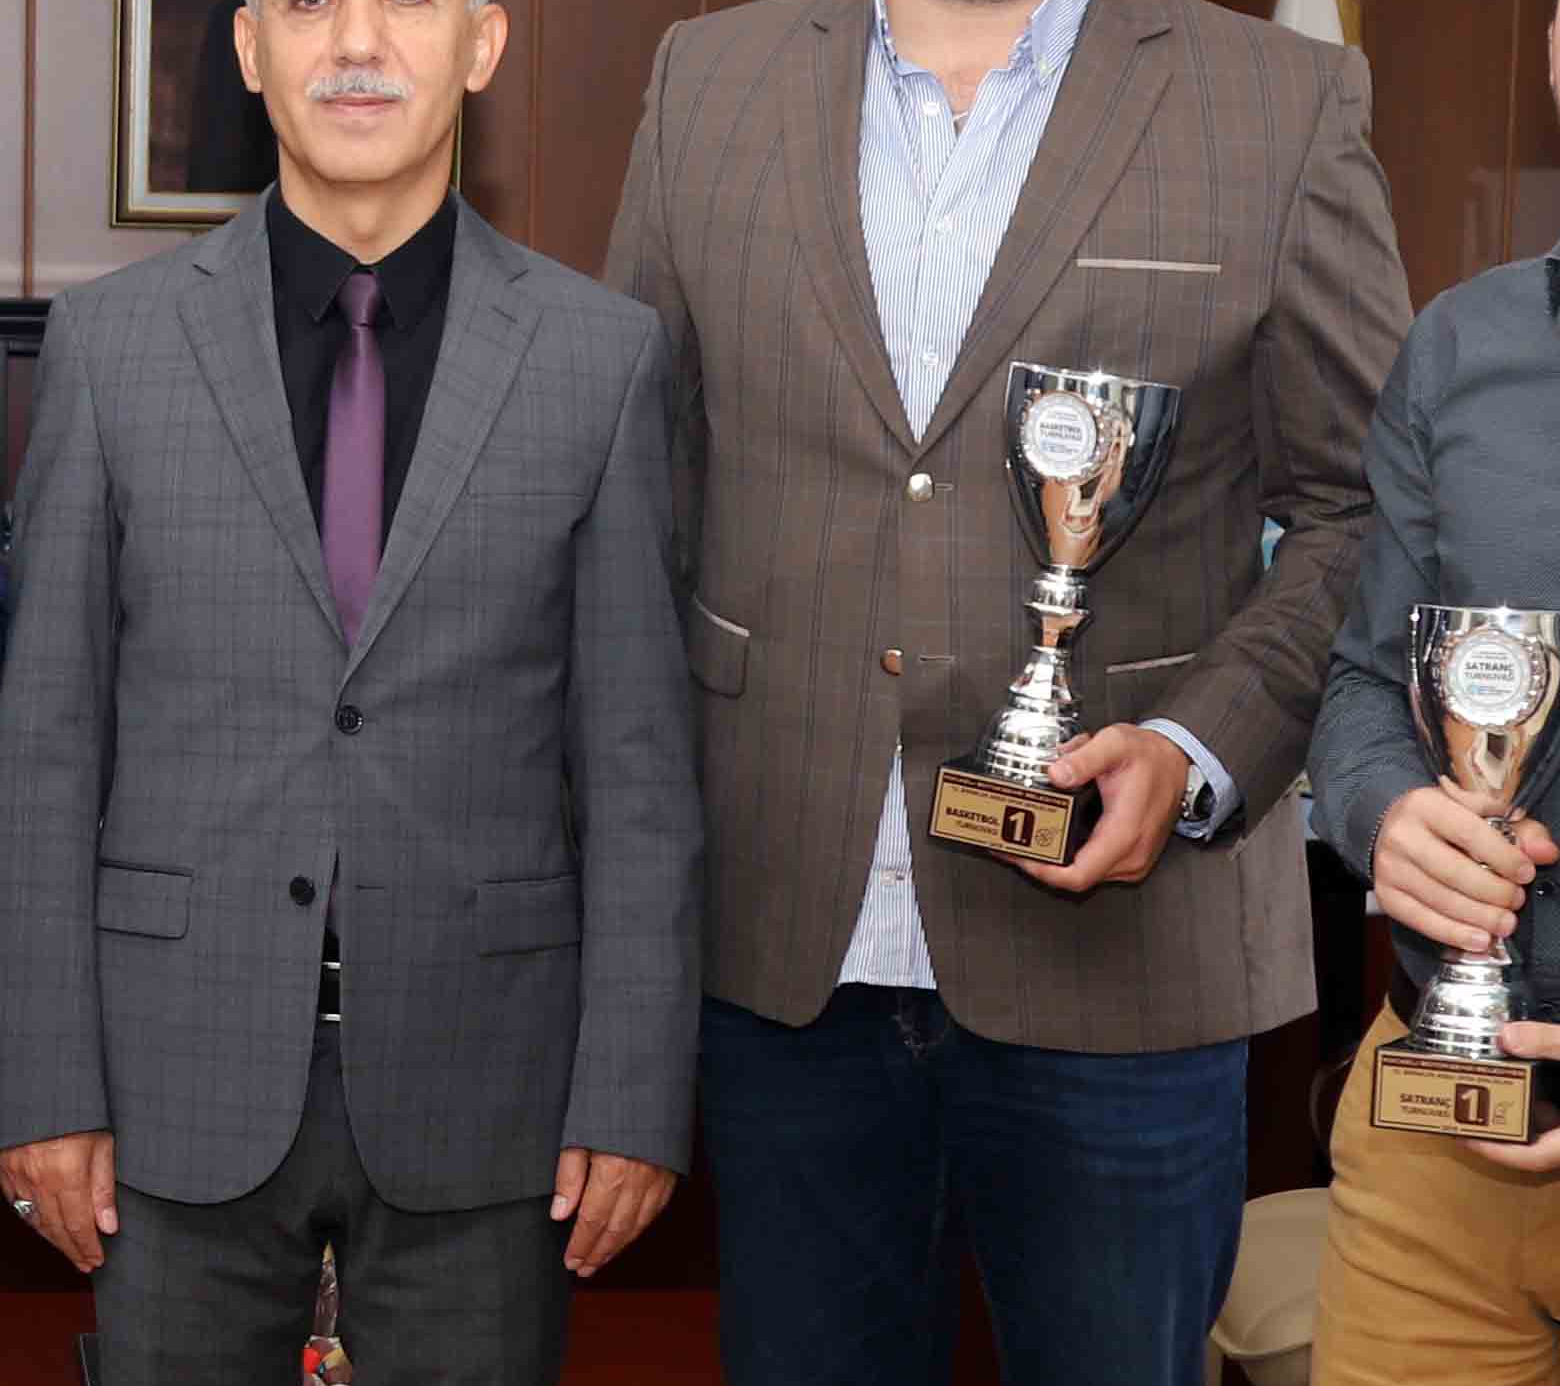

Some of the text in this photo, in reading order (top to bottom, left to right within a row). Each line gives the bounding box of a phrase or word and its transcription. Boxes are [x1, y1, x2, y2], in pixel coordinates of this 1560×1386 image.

[1464, 661, 1514, 671] SATRANÇ
[945, 806, 1000, 825] BASKETBOL
[1400, 1093, 1451, 1109] SATRANÇ
